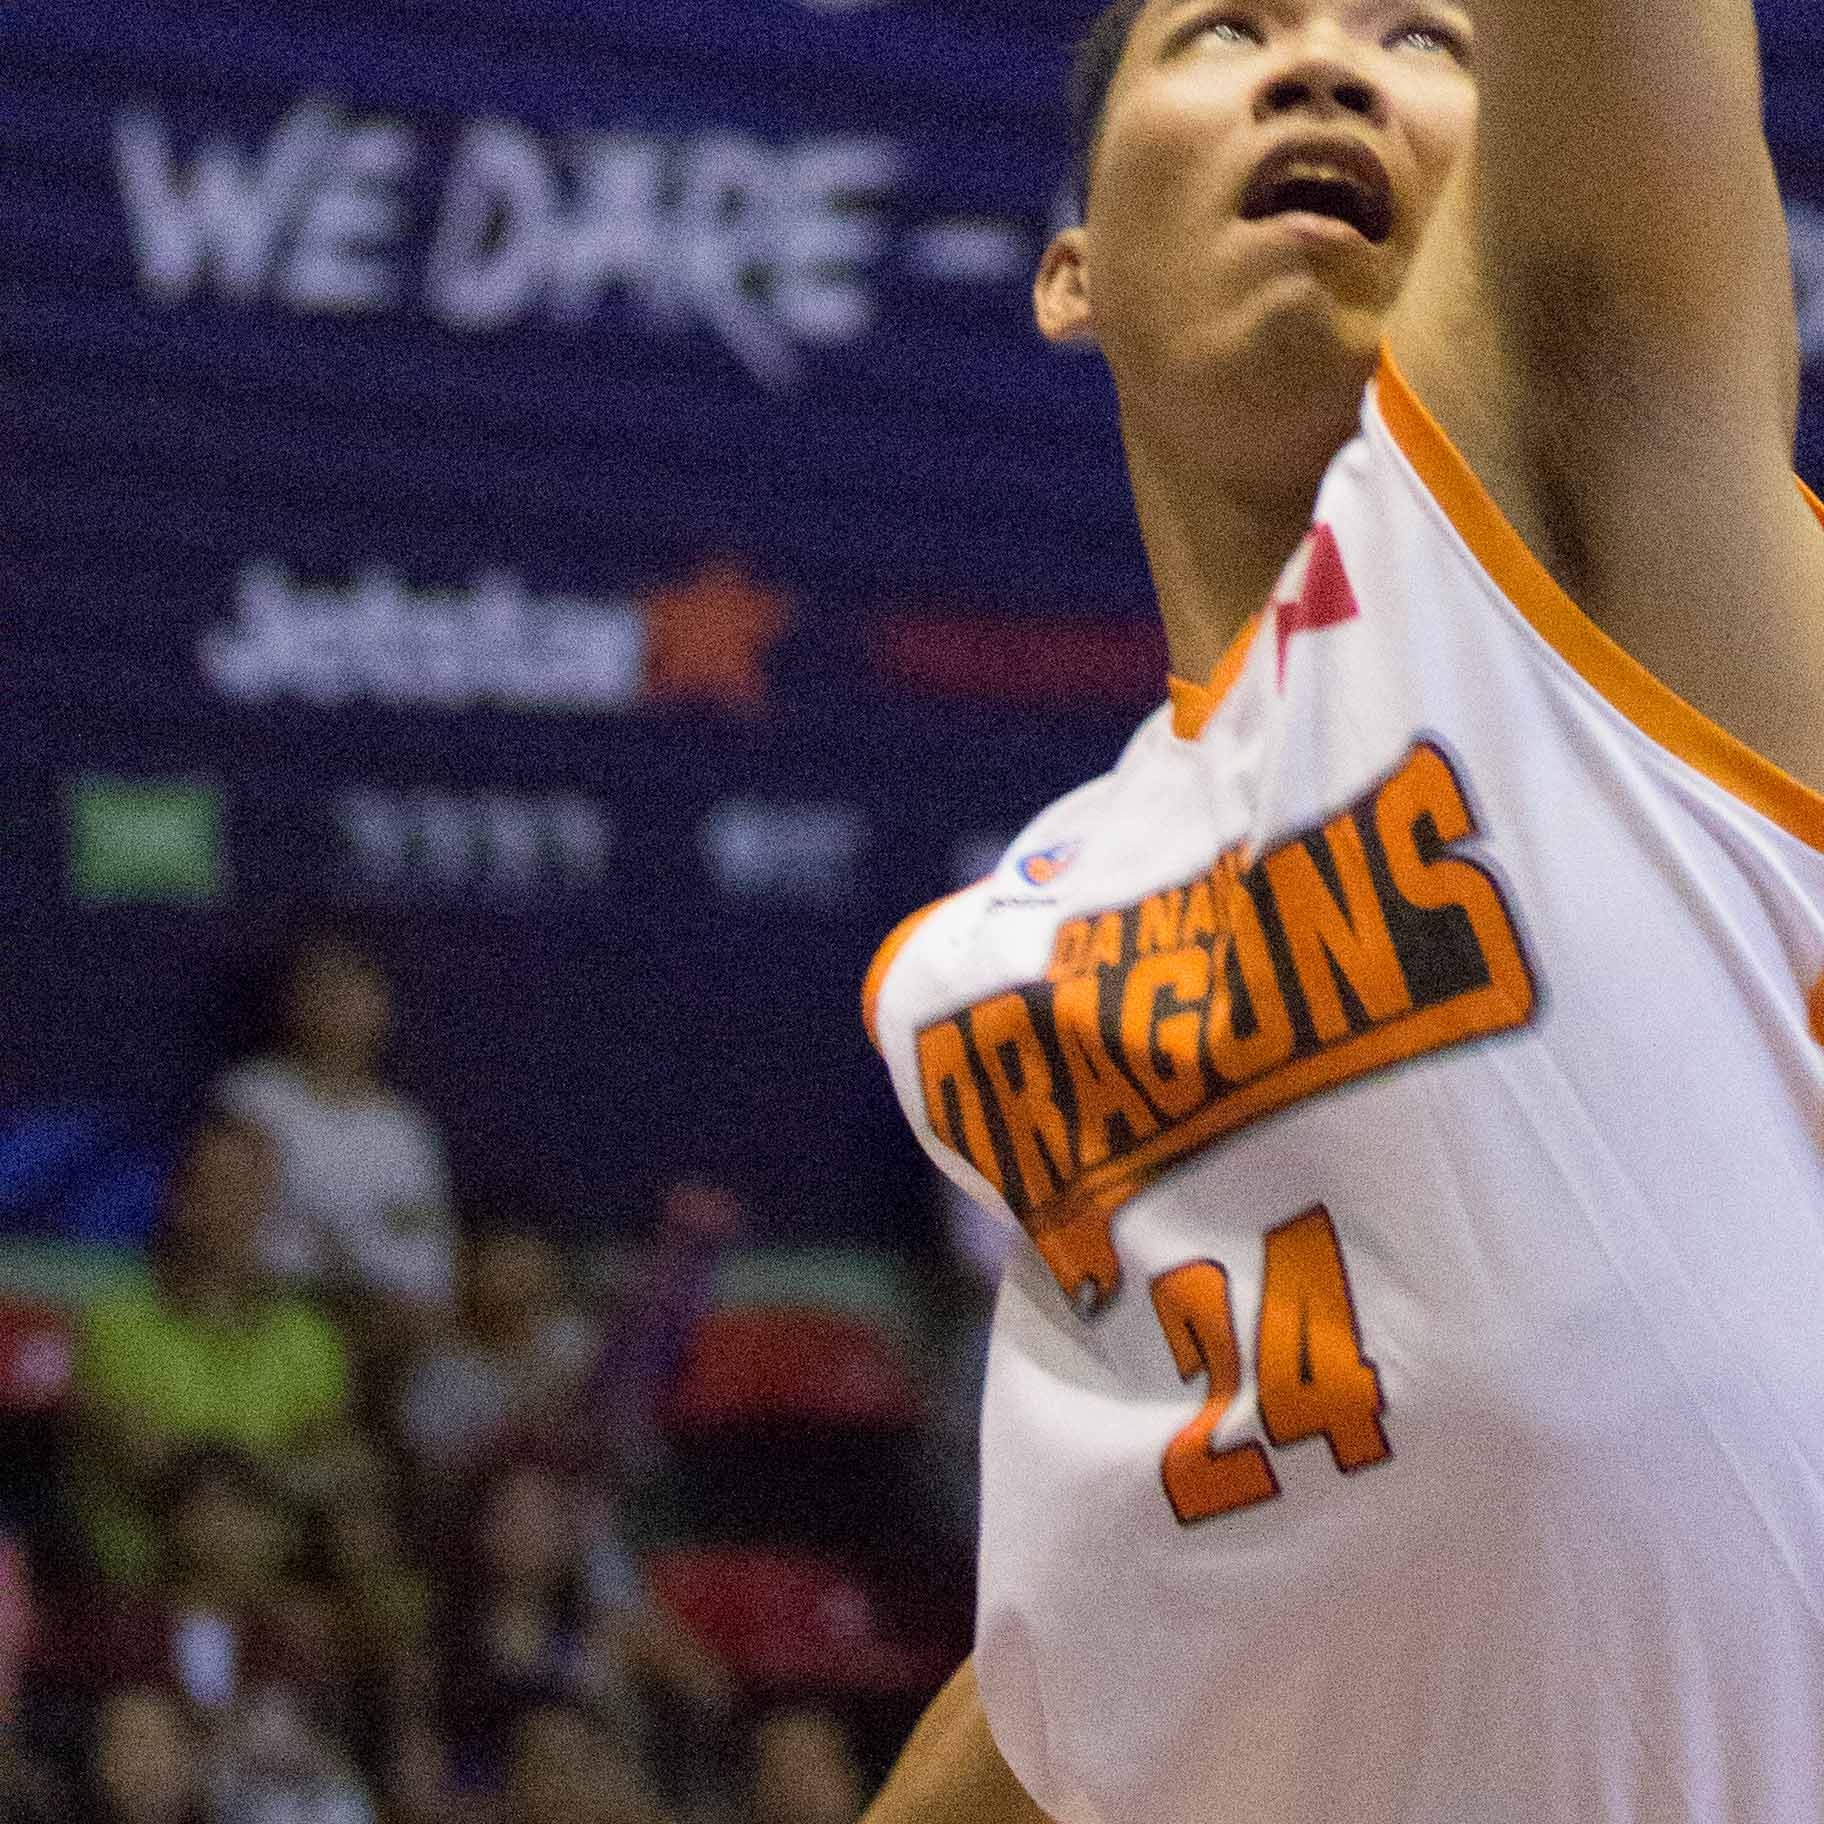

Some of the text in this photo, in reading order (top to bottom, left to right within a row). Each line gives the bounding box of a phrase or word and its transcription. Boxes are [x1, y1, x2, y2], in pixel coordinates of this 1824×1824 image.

[112, 97, 408, 308] WE
[427, 112, 903, 386] DARE
[199, 564, 647, 708] Jetstar
[913, 737, 1538, 1210] DRAGONS
[1150, 1200, 1395, 1530] 24
